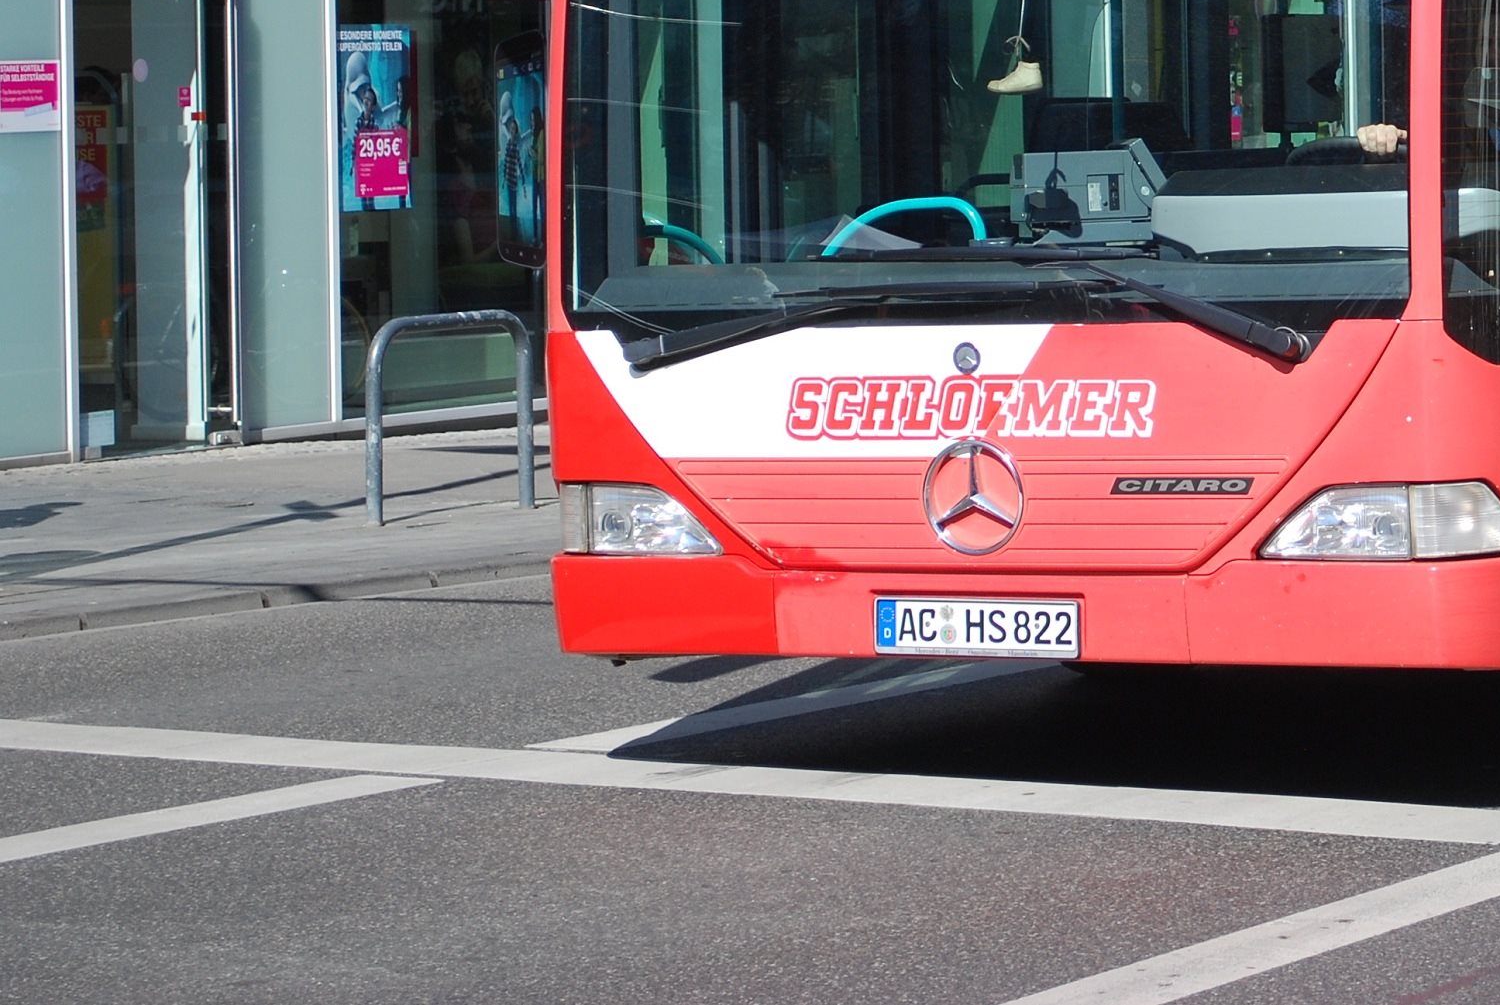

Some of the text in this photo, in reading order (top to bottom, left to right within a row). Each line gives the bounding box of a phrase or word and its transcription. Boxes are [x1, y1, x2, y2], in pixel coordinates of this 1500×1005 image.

[1118, 479, 1247, 492] CITARO
[884, 628, 892, 639] D
[899, 608, 937, 642] AC
